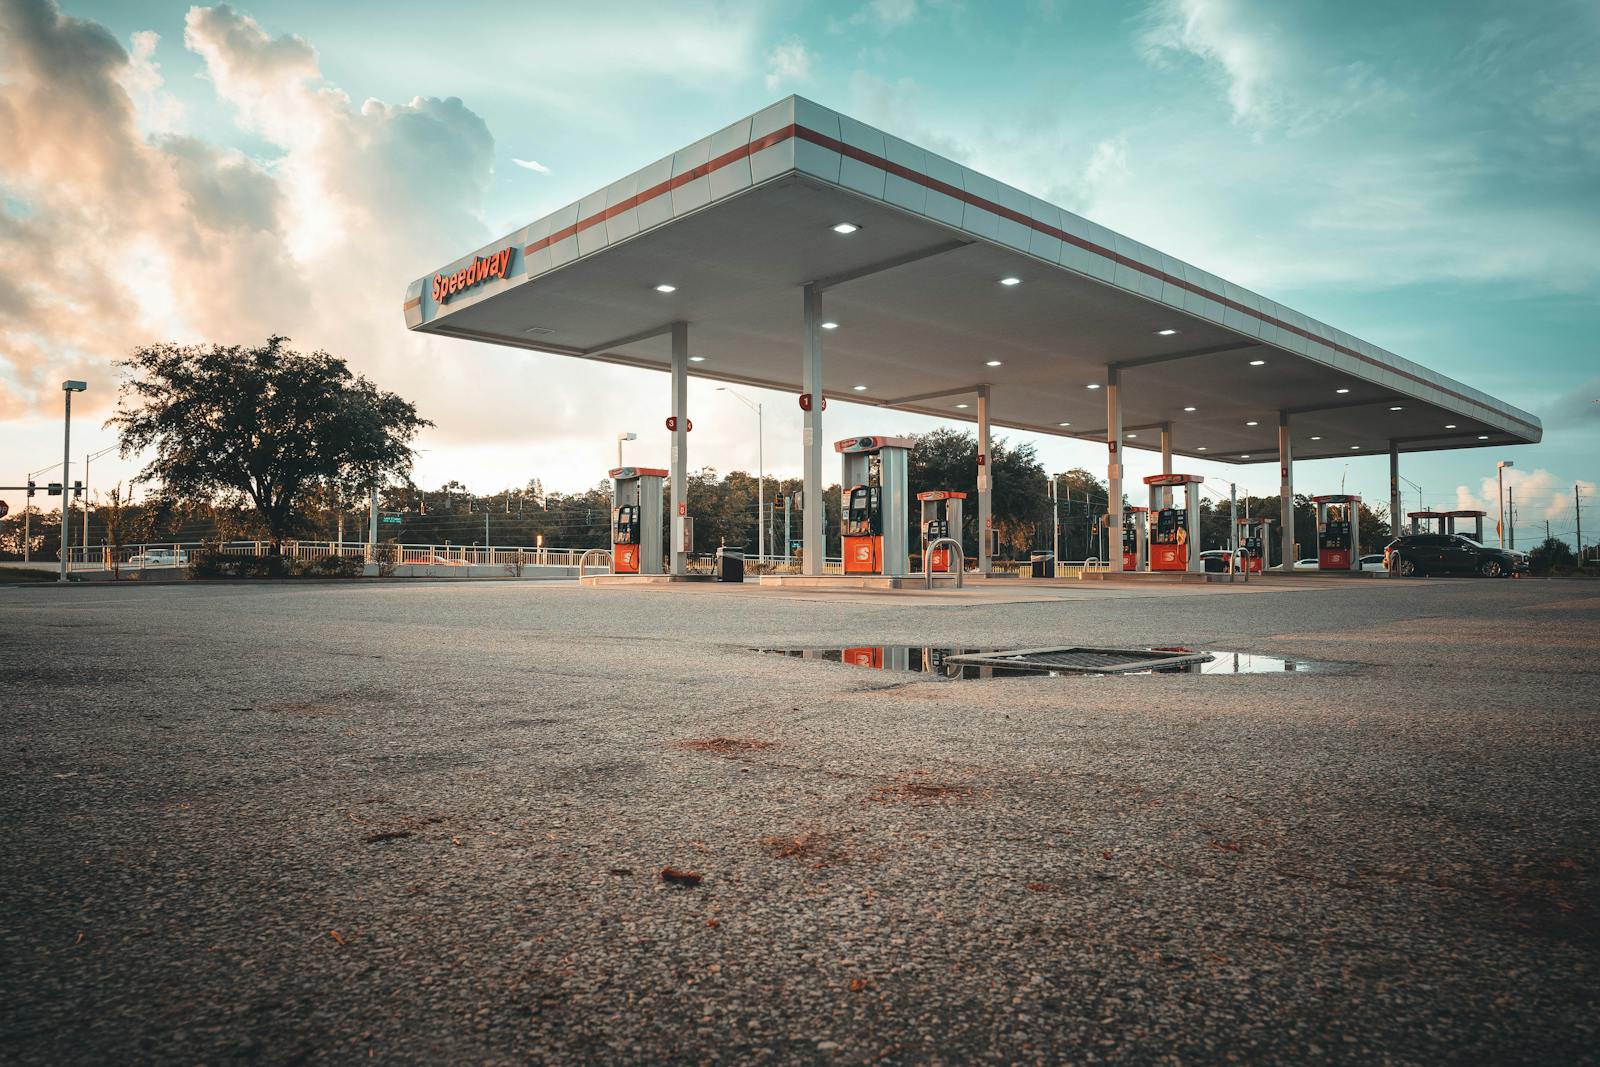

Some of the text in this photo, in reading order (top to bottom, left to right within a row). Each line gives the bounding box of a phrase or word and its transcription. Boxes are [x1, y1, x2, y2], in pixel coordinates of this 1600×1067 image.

[431, 246, 514, 304] Speedway
[857, 547, 869, 560] S
[1163, 551, 1175, 562] S
